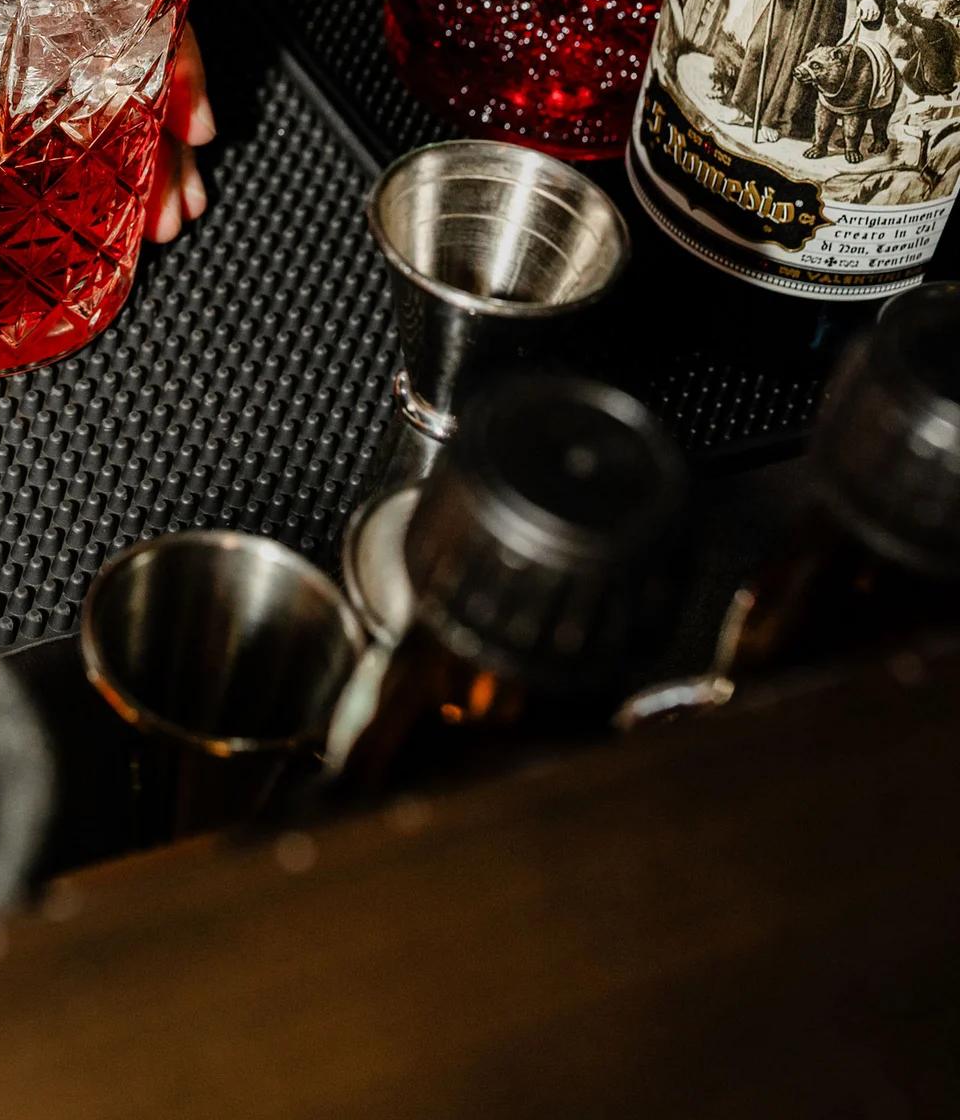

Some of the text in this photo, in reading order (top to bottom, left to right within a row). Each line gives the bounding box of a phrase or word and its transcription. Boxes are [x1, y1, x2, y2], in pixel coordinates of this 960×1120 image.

[836, 207, 946, 228] Artigianalmente
[834, 221, 937, 240] creato in Val
[820, 241, 833, 251] di
[868, 251, 923, 268] Trentino
